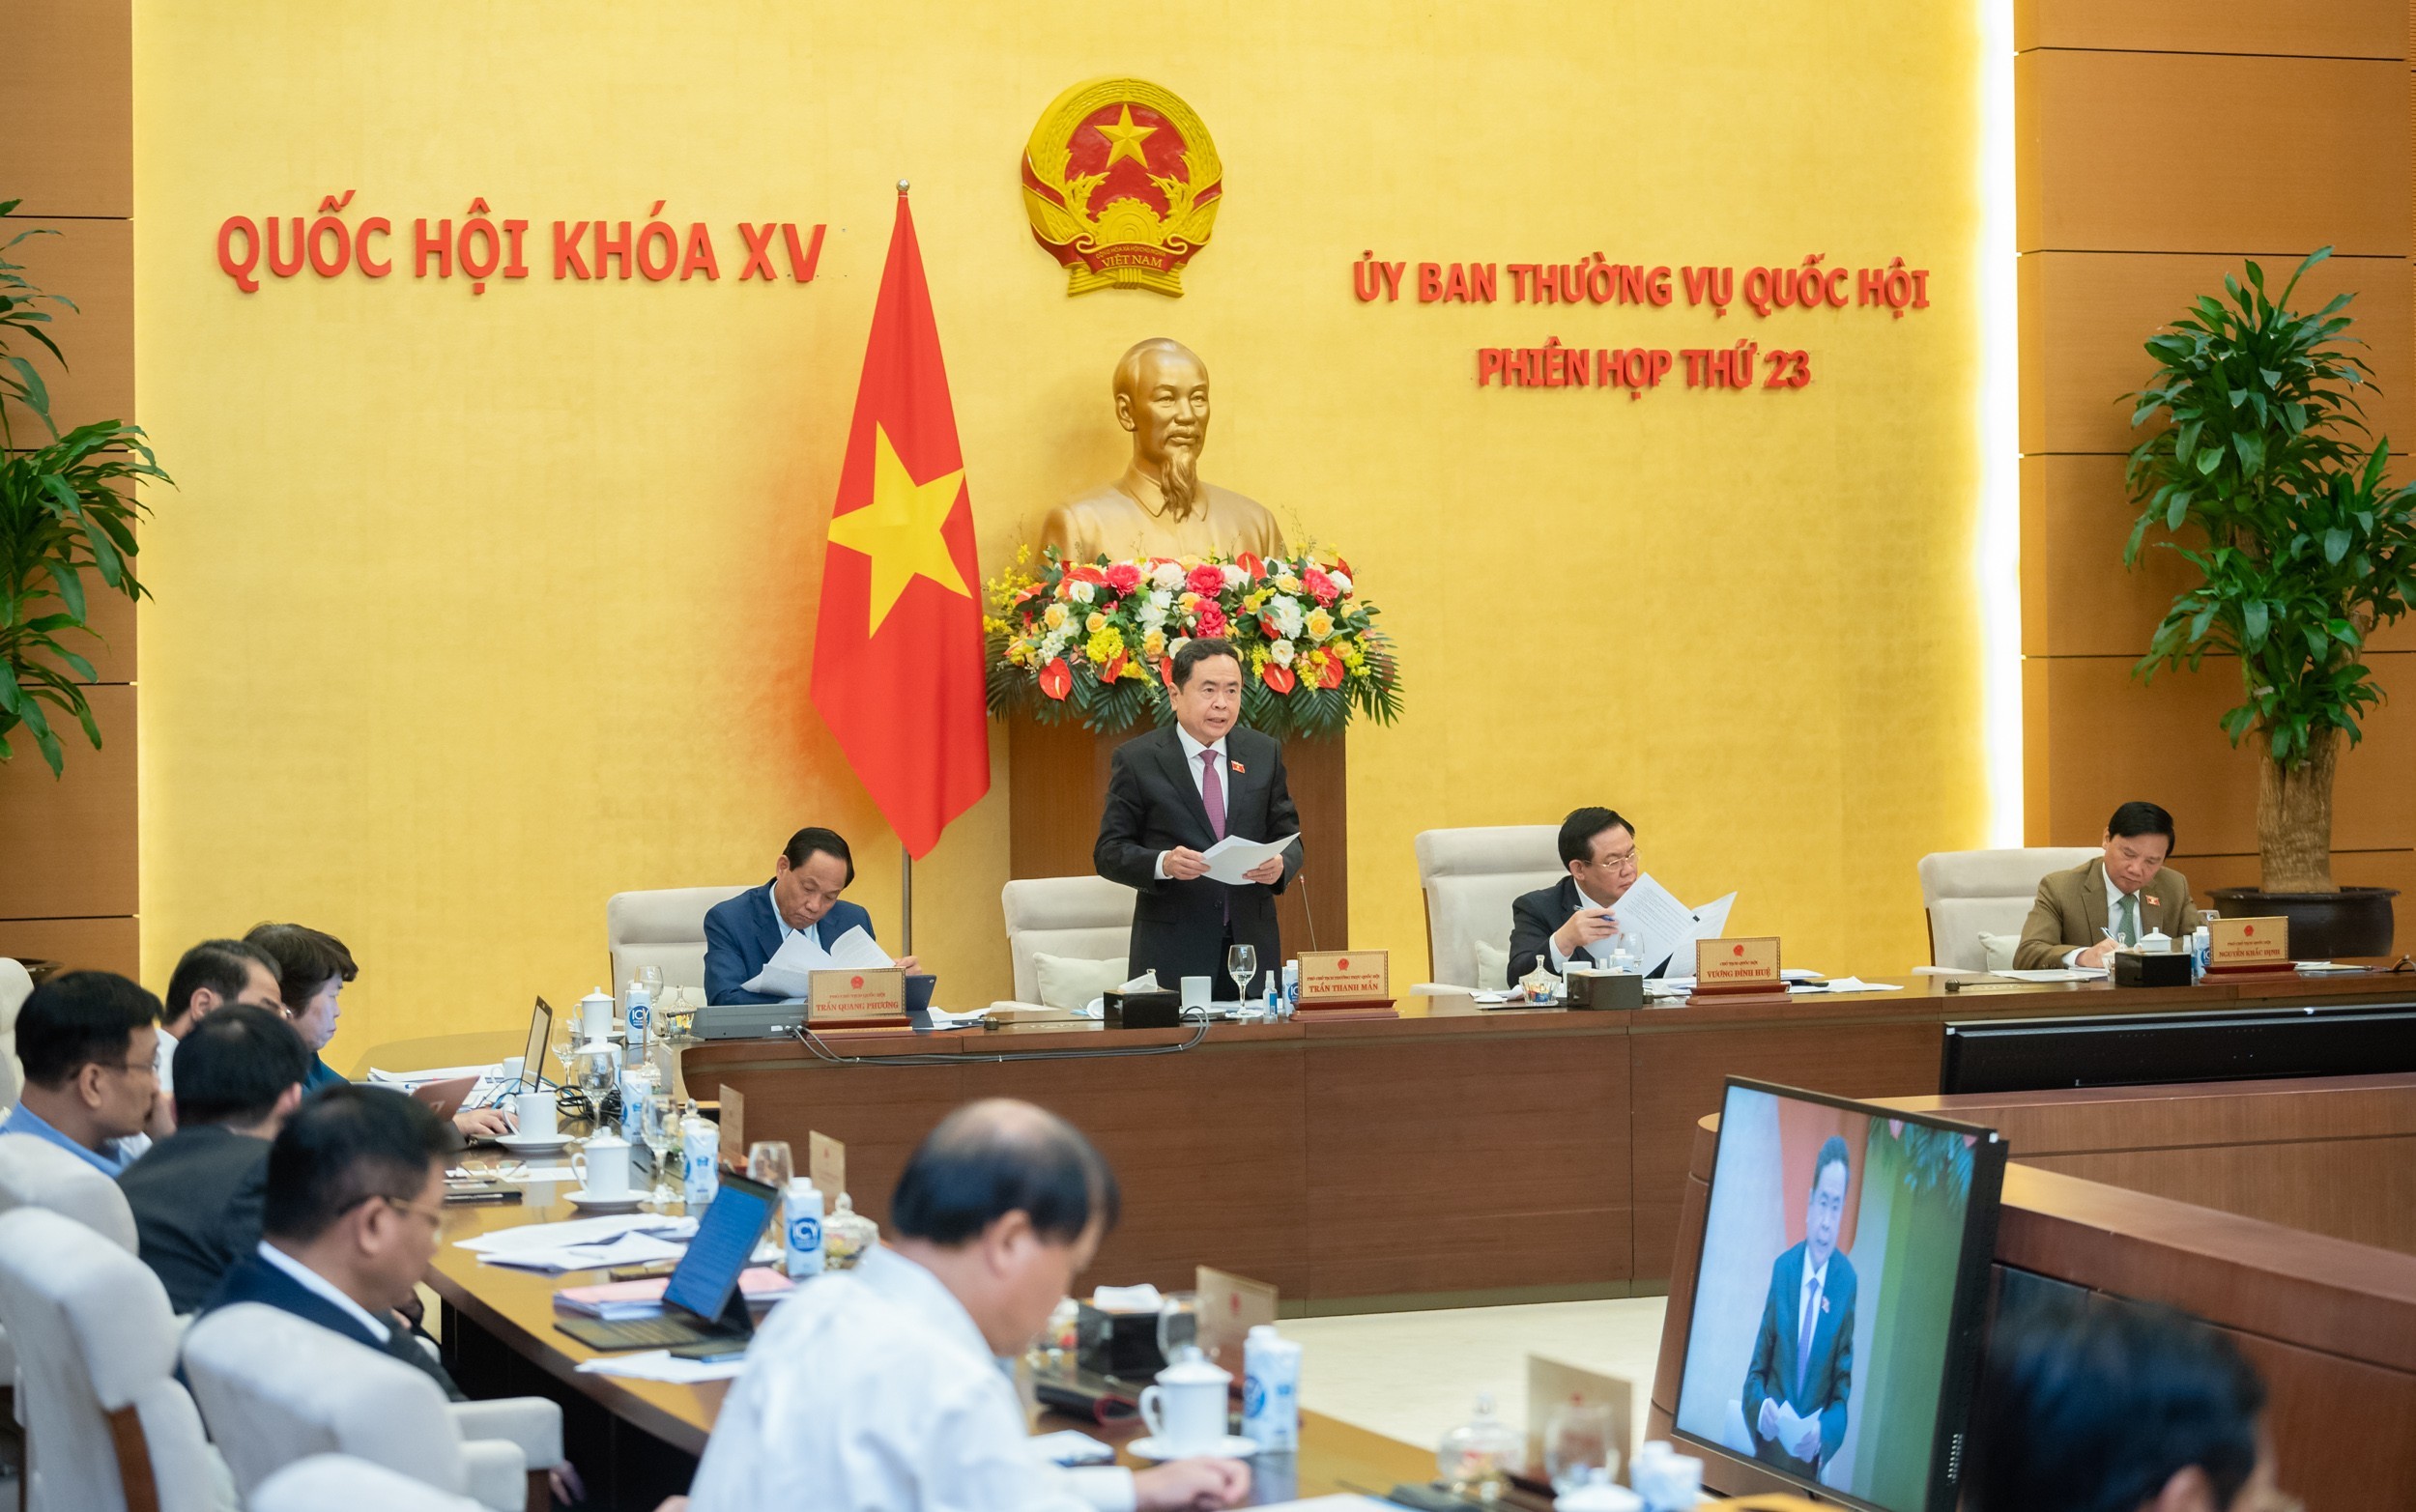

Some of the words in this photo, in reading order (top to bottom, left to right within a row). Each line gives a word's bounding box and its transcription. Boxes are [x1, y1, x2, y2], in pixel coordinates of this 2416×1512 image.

[216, 189, 391, 293] QUỐC
[415, 197, 529, 295] HỘI
[554, 200, 720, 281] KHÓA
[738, 223, 826, 282] XV
[1132, 254, 1163, 268] NAM
[1353, 250, 1406, 302] ỦY
[1418, 263, 1497, 303] BAN
[1508, 251, 1672, 305] THƯỜNG
[1683, 266, 1734, 317] VỤ
[1743, 252, 1848, 316] QUỐC
[1857, 256, 1930, 319] HỘI
[1478, 336, 1590, 387] PHIÊN
[1597, 348, 1673, 400] HỌP
[1680, 338, 1758, 388] THỨ
[1764, 349, 1812, 388] 23
[1707, 969, 1733, 978] VƯƠNG
[1735, 967, 1753, 977] ĐÌNH
[1755, 966, 1770, 978] HUỆ
[1309, 982, 1330, 992] TRẦN
[1332, 984, 1359, 992] THANH
[816, 1001, 836, 1012] TRẦN
[838, 1003, 865, 1012] QUANG
[867, 1001, 899, 1010] PHƯƠNG
